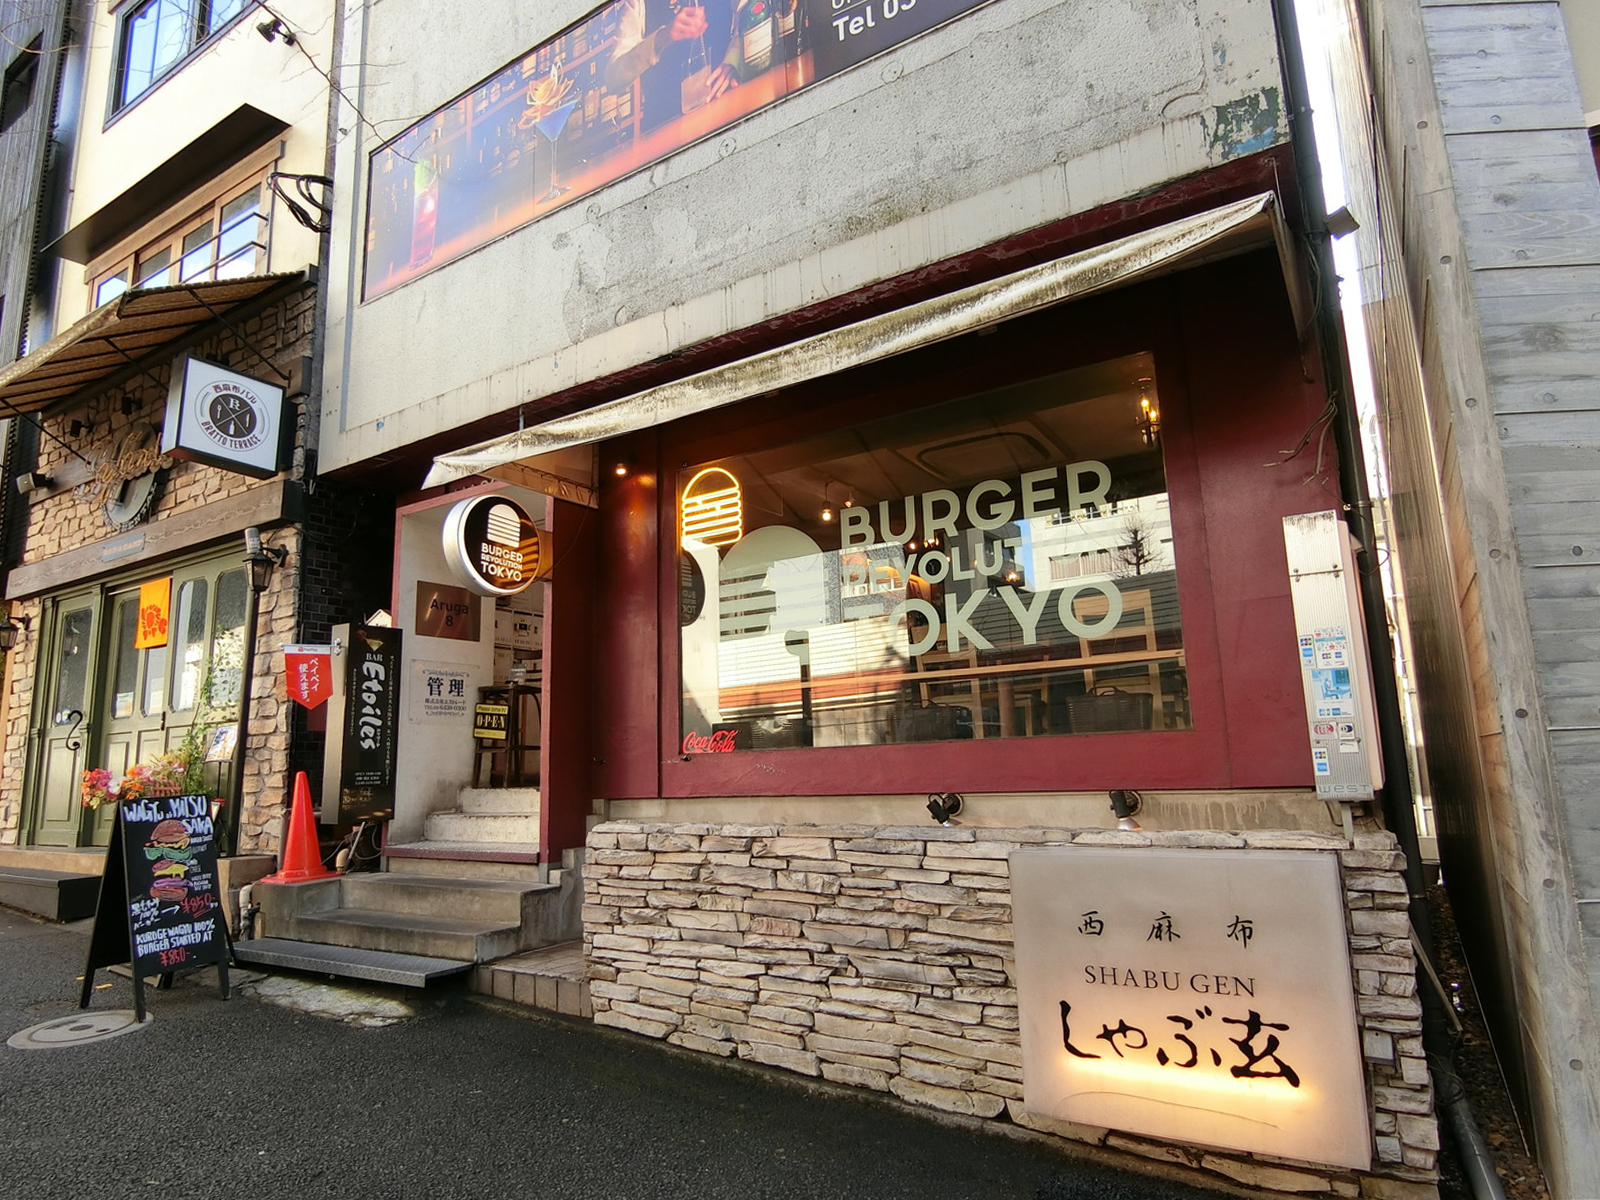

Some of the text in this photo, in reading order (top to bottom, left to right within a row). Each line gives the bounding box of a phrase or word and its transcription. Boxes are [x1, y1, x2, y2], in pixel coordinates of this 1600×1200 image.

[832, 5, 876, 41] Tel
[201, 420, 262, 450] BRATTO TERRACE
[839, 460, 1112, 548] BURGER
[480, 552, 523, 571] REVOLUTION
[481, 542, 524, 563] BURGER
[480, 560, 522, 582] TOKYO
[430, 599, 469, 614] Aruga
[445, 616, 454, 627] 8
[366, 653, 383, 662] BAR
[298, 663, 311, 702] 使えます。
[309, 657, 320, 692] ペイペイ
[427, 676, 465, 698] 管理
[360, 661, 386, 750] Etoiles
[136, 918, 216, 945] KUROGE WAGYU 100%
[137, 939, 171, 958] BURGER
[202, 930, 214, 942] AT
[1077, 910, 1255, 949] 西麻布
[1084, 965, 1256, 999] SHABU GEN
[1059, 1000, 1301, 1089] しゃぶ玄
